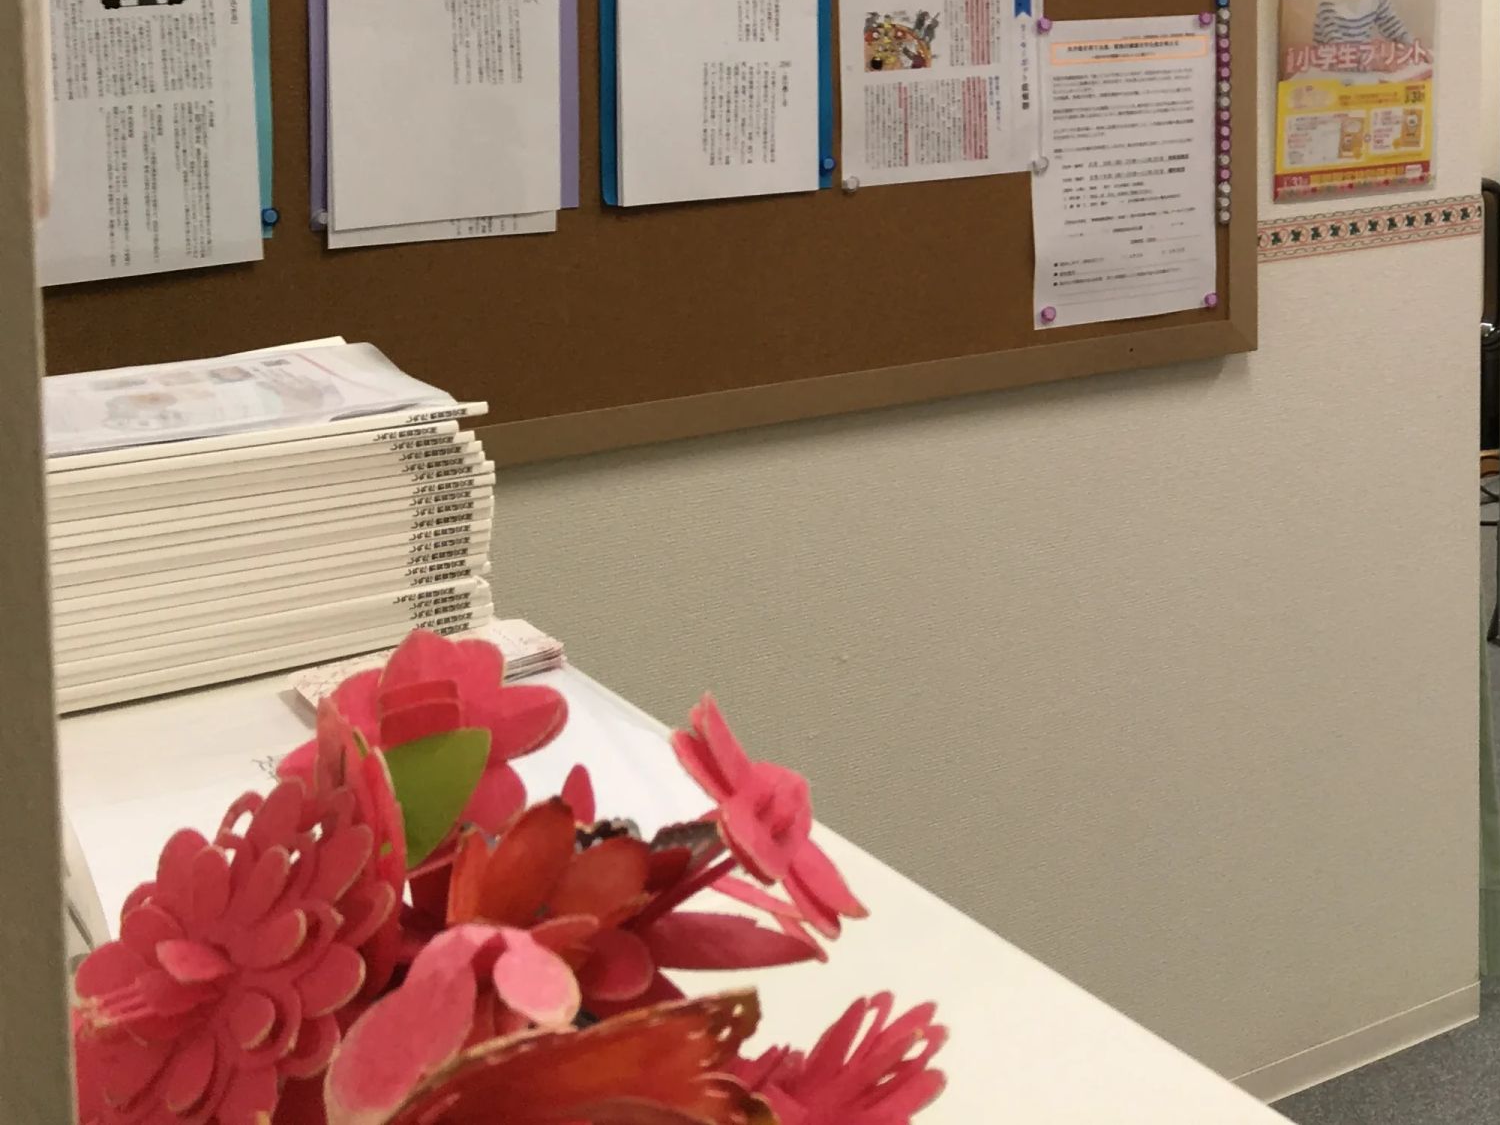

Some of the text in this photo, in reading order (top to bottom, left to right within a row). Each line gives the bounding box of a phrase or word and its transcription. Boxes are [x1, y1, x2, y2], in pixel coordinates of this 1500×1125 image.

[1296, 40, 1428, 72] 小学生プリント
